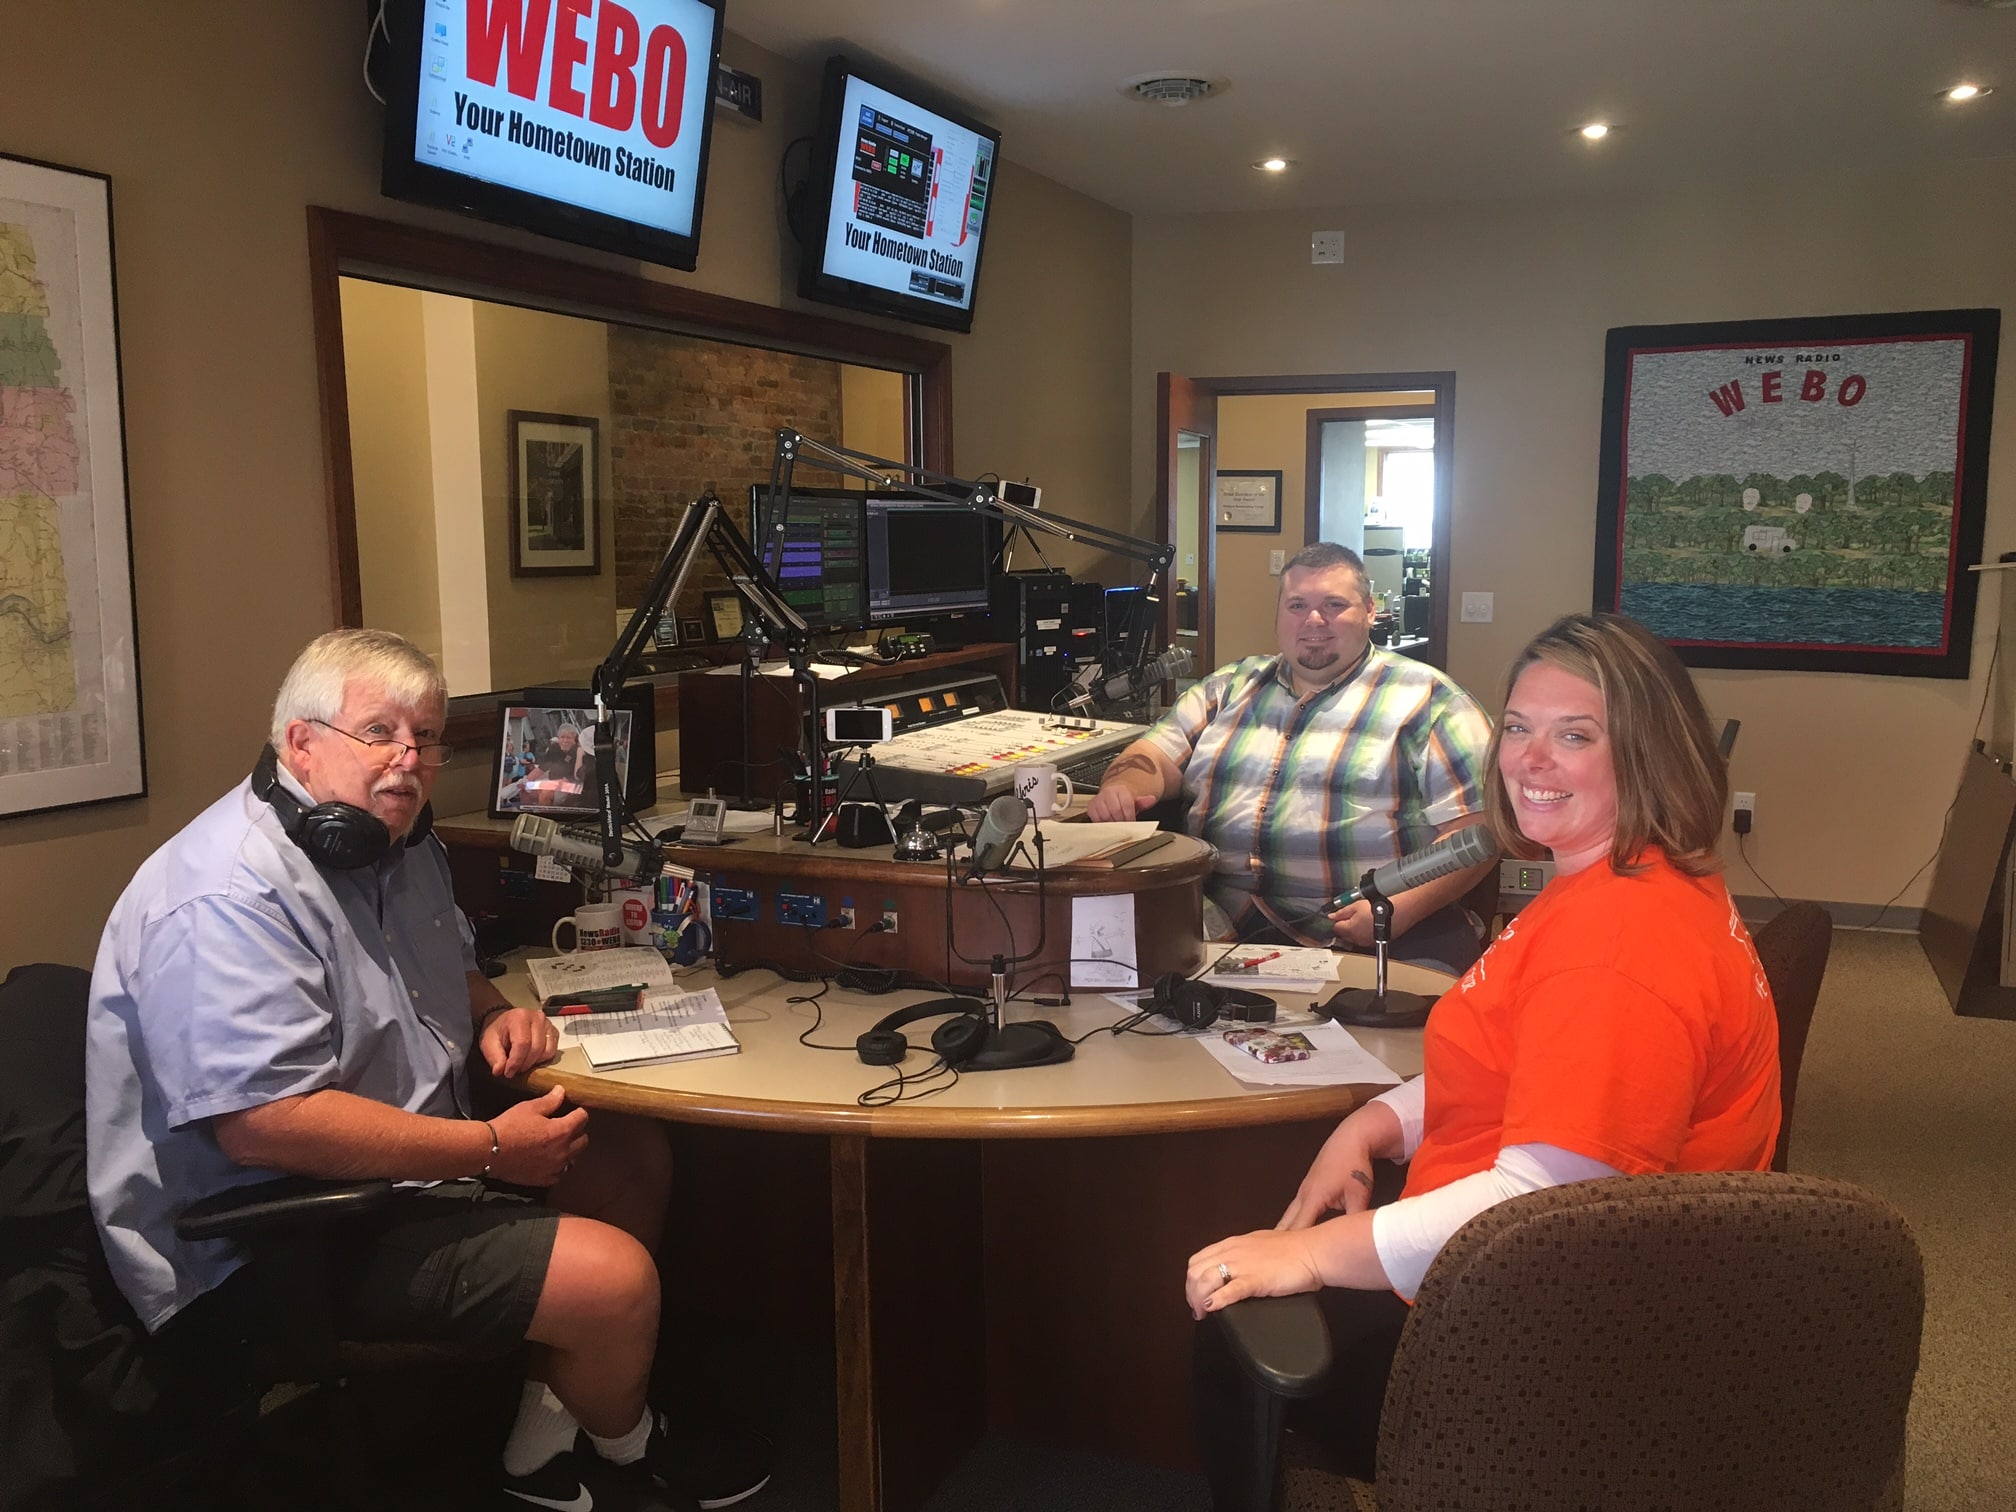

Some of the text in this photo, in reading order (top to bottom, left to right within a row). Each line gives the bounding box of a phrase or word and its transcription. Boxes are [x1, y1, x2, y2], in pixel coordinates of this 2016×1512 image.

[465, 0, 687, 149] WEBO
[454, 91, 505, 138] Your
[508, 109, 611, 173] Hometown
[615, 146, 675, 192] Station
[845, 221, 963, 278] Your Hometown Station
[1745, 352, 1842, 365] NEWS RADIO
[1708, 369, 1867, 417] WEBO
